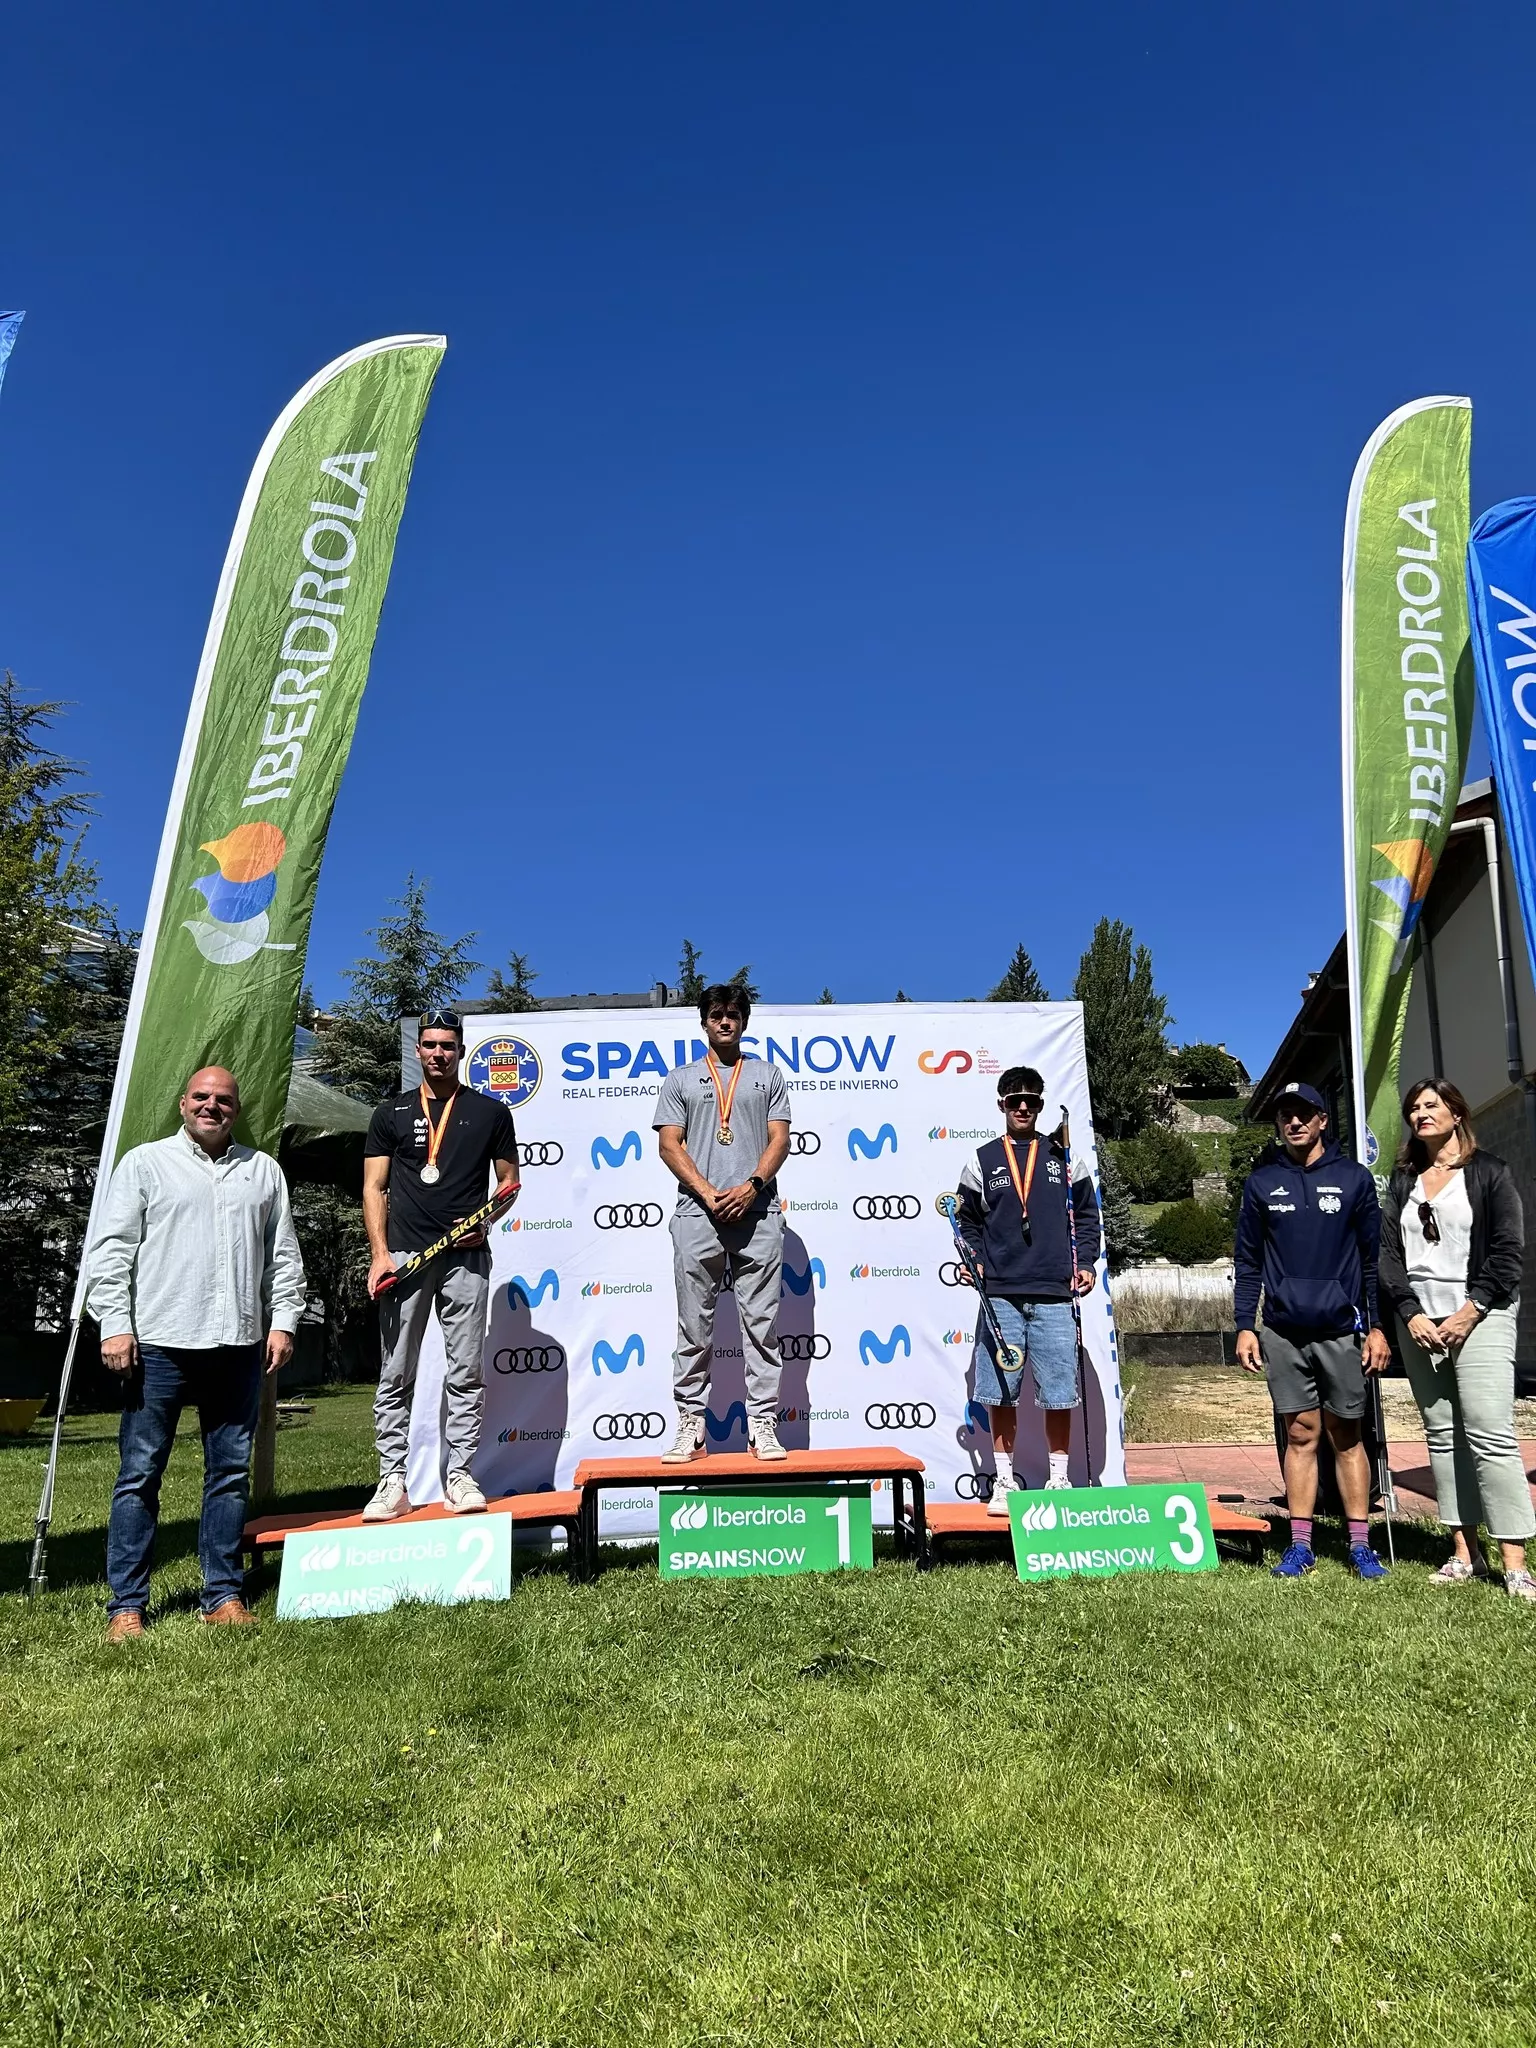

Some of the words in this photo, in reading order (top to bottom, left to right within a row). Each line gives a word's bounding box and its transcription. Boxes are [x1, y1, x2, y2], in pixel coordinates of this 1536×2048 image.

[241, 449, 378, 809] IBERDROLA
[1395, 498, 1446, 827] IBERDROLA
[490, 1057, 517, 1066] RFEDI
[562, 1088, 596, 1099] REAL
[598, 1085, 662, 1098] FEDERACI
[820, 1080, 836, 1090] DE
[839, 1079, 899, 1090] INVIERNO
[949, 1128, 997, 1138] Iberdrola
[789, 1199, 838, 1211] Iberdrola
[423, 1235, 448, 1261] SKI
[450, 1200, 494, 1241] SKETT
[522, 1218, 573, 1231] Iberdrola
[871, 1265, 920, 1277] Iberdrola
[602, 1282, 653, 1295] Iberdrola
[713, 1346, 744, 1358] drola
[798, 1408, 850, 1421] Iberdrola
[519, 1427, 571, 1442] Iberdrola
[601, 1498, 654, 1511] Iberdrola
[713, 1504, 806, 1528] Iberdrola
[1060, 1503, 1151, 1528] Iberdrola
[825, 1496, 850, 1565] 1
[1164, 1494, 1205, 1566] 3
[344, 1540, 448, 1568] Iberdrola
[455, 1526, 495, 1597] 2
[669, 1547, 806, 1570] SPAINSNOW
[1026, 1546, 1155, 1573] SPAINSNOW
